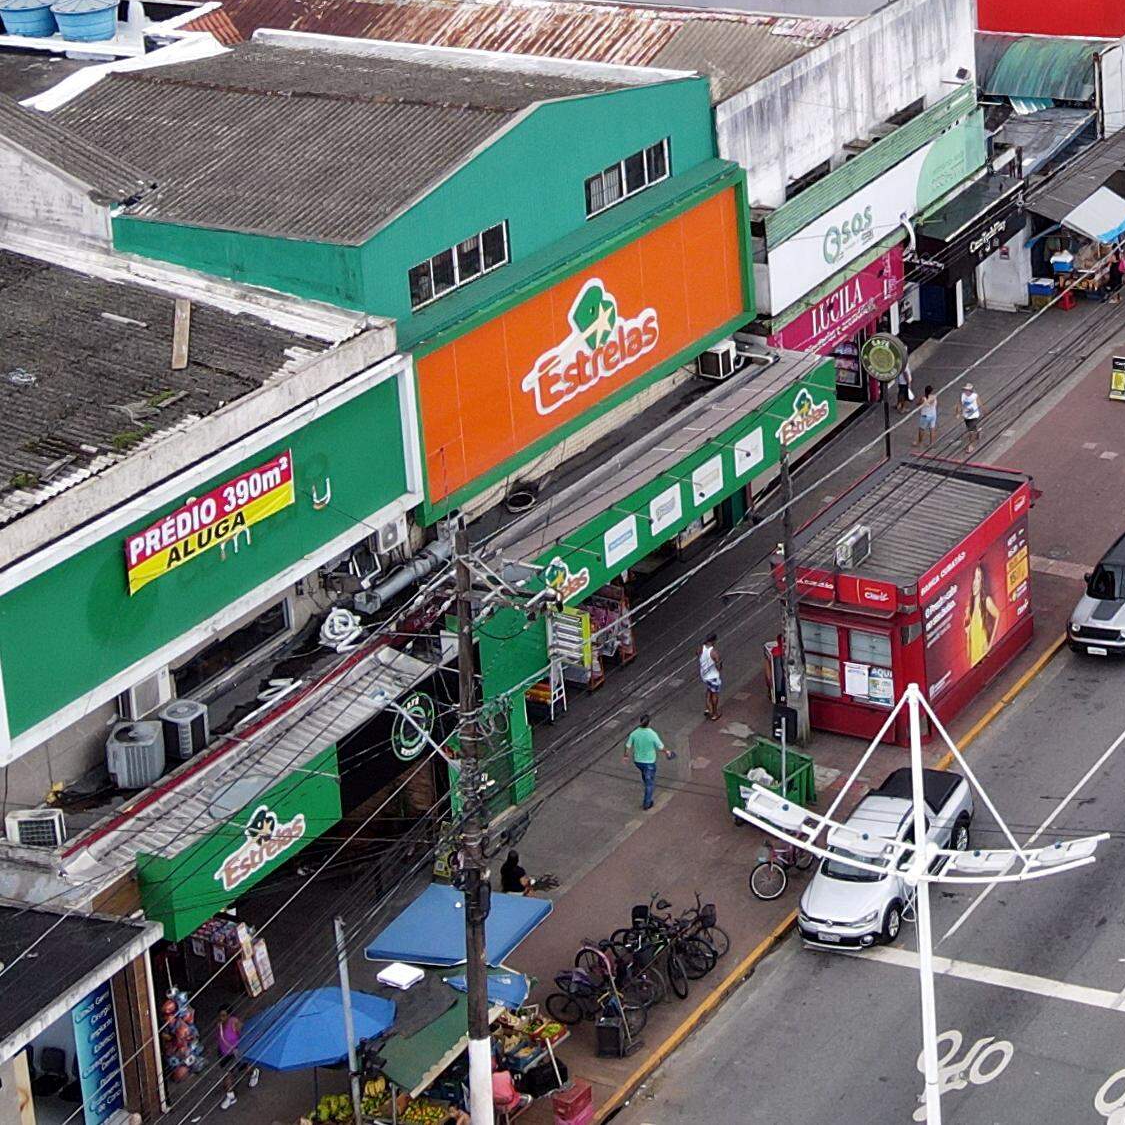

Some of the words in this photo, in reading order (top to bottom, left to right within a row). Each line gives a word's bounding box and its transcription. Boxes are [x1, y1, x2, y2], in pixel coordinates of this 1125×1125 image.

[811, 277, 864, 338] LUCILA
[536, 312, 659, 411] Estrelas
[781, 402, 828, 445] Estrelas
[129, 497, 216, 566] PRÉDIO
[222, 456, 288, 513] 390m²
[166, 511, 246, 569] ALUGA
[222, 816, 305, 889] Estrelas
